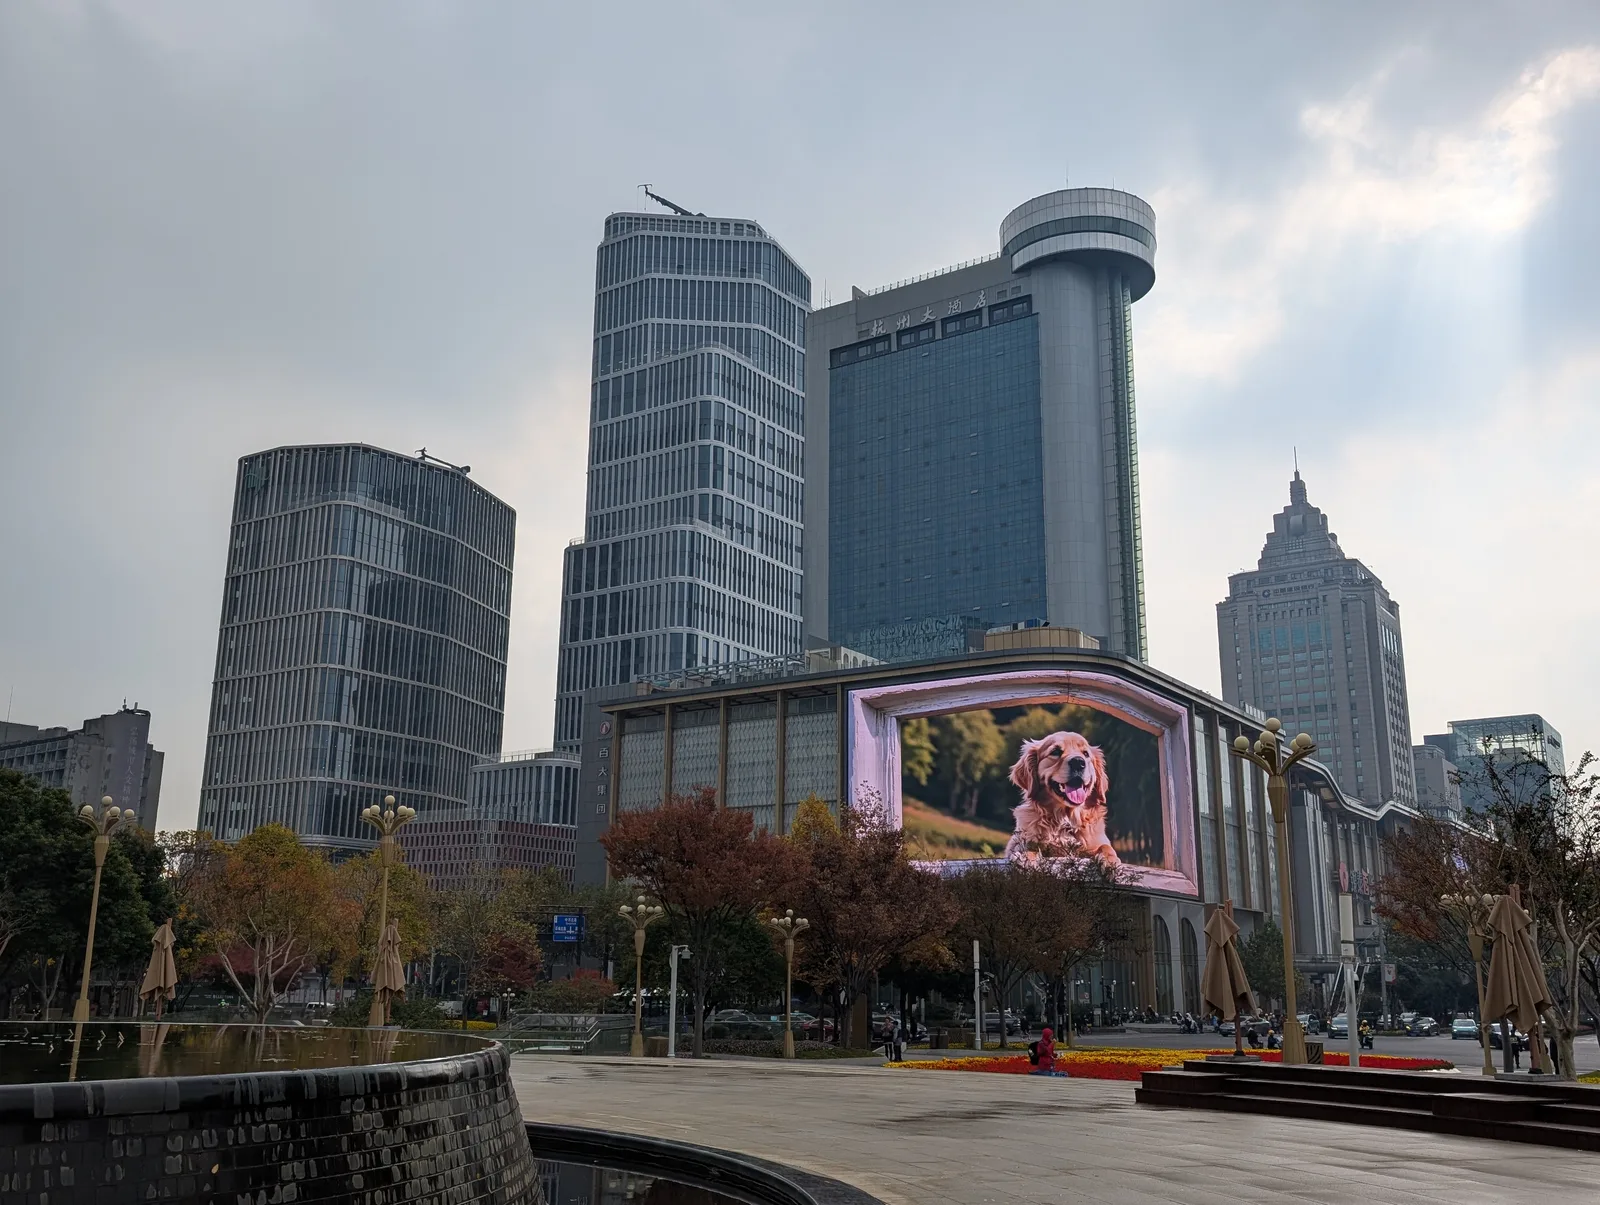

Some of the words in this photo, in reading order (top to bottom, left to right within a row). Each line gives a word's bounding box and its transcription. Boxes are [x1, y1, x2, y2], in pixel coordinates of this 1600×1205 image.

[870, 289, 988, 338] 杭州大酒店
[596, 747, 609, 814] 百大集团
